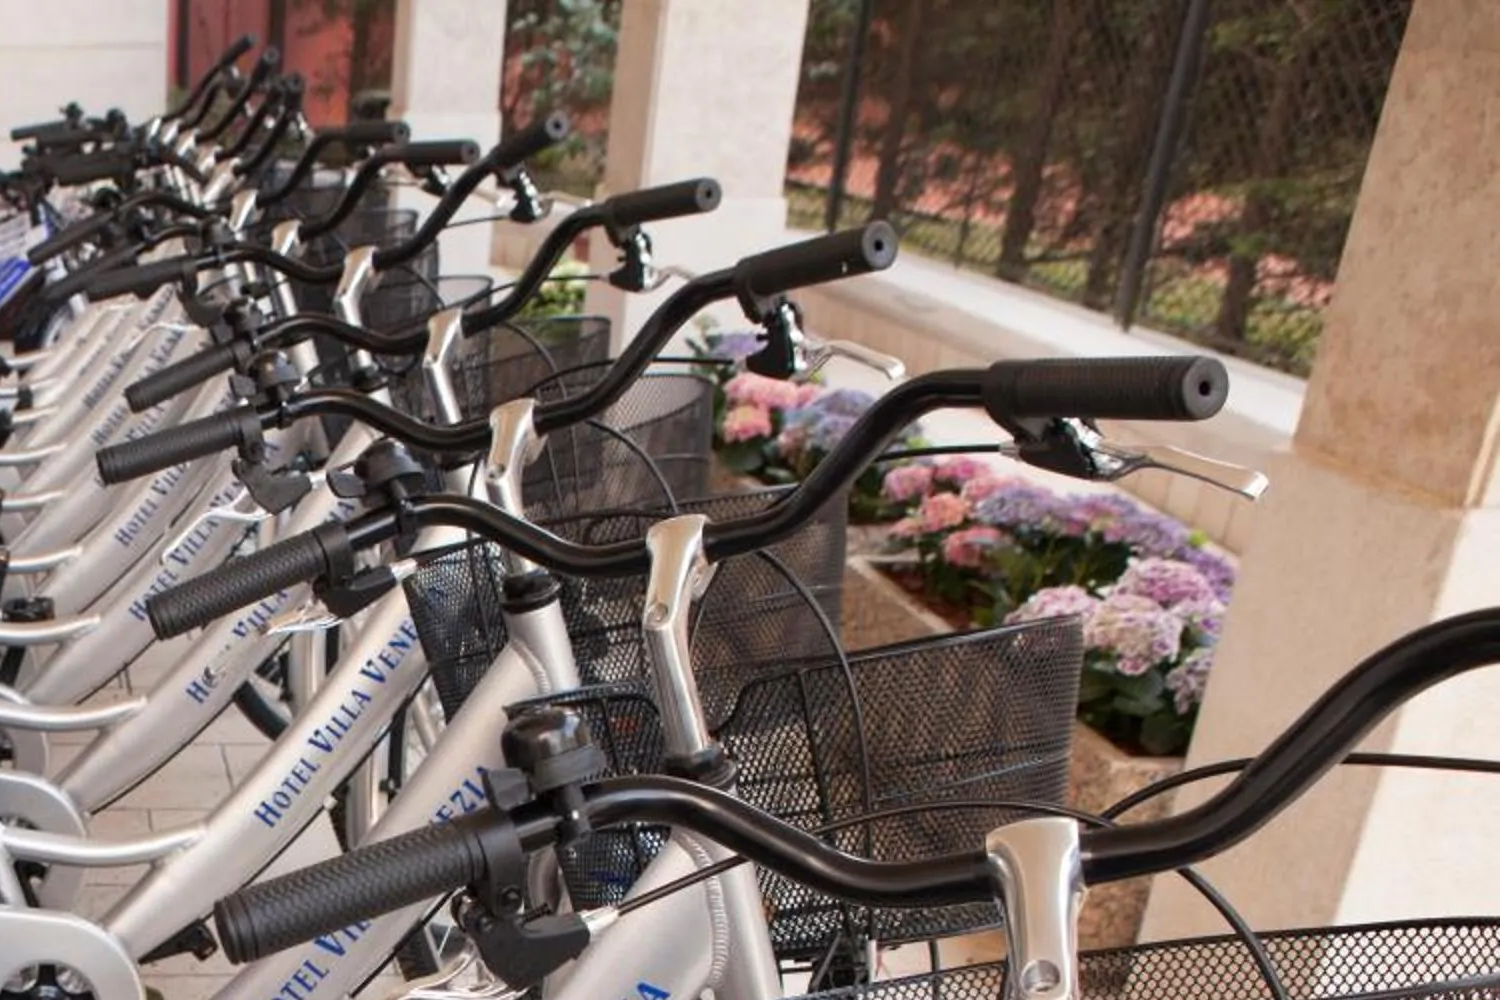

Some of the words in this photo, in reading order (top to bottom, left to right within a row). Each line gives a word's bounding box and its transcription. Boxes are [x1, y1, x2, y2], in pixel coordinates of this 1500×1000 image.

[168, 517, 219, 567] VILLA
[253, 757, 322, 829] HOTEL
[307, 688, 373, 753] VILLA
[359, 618, 419, 684] VENE
